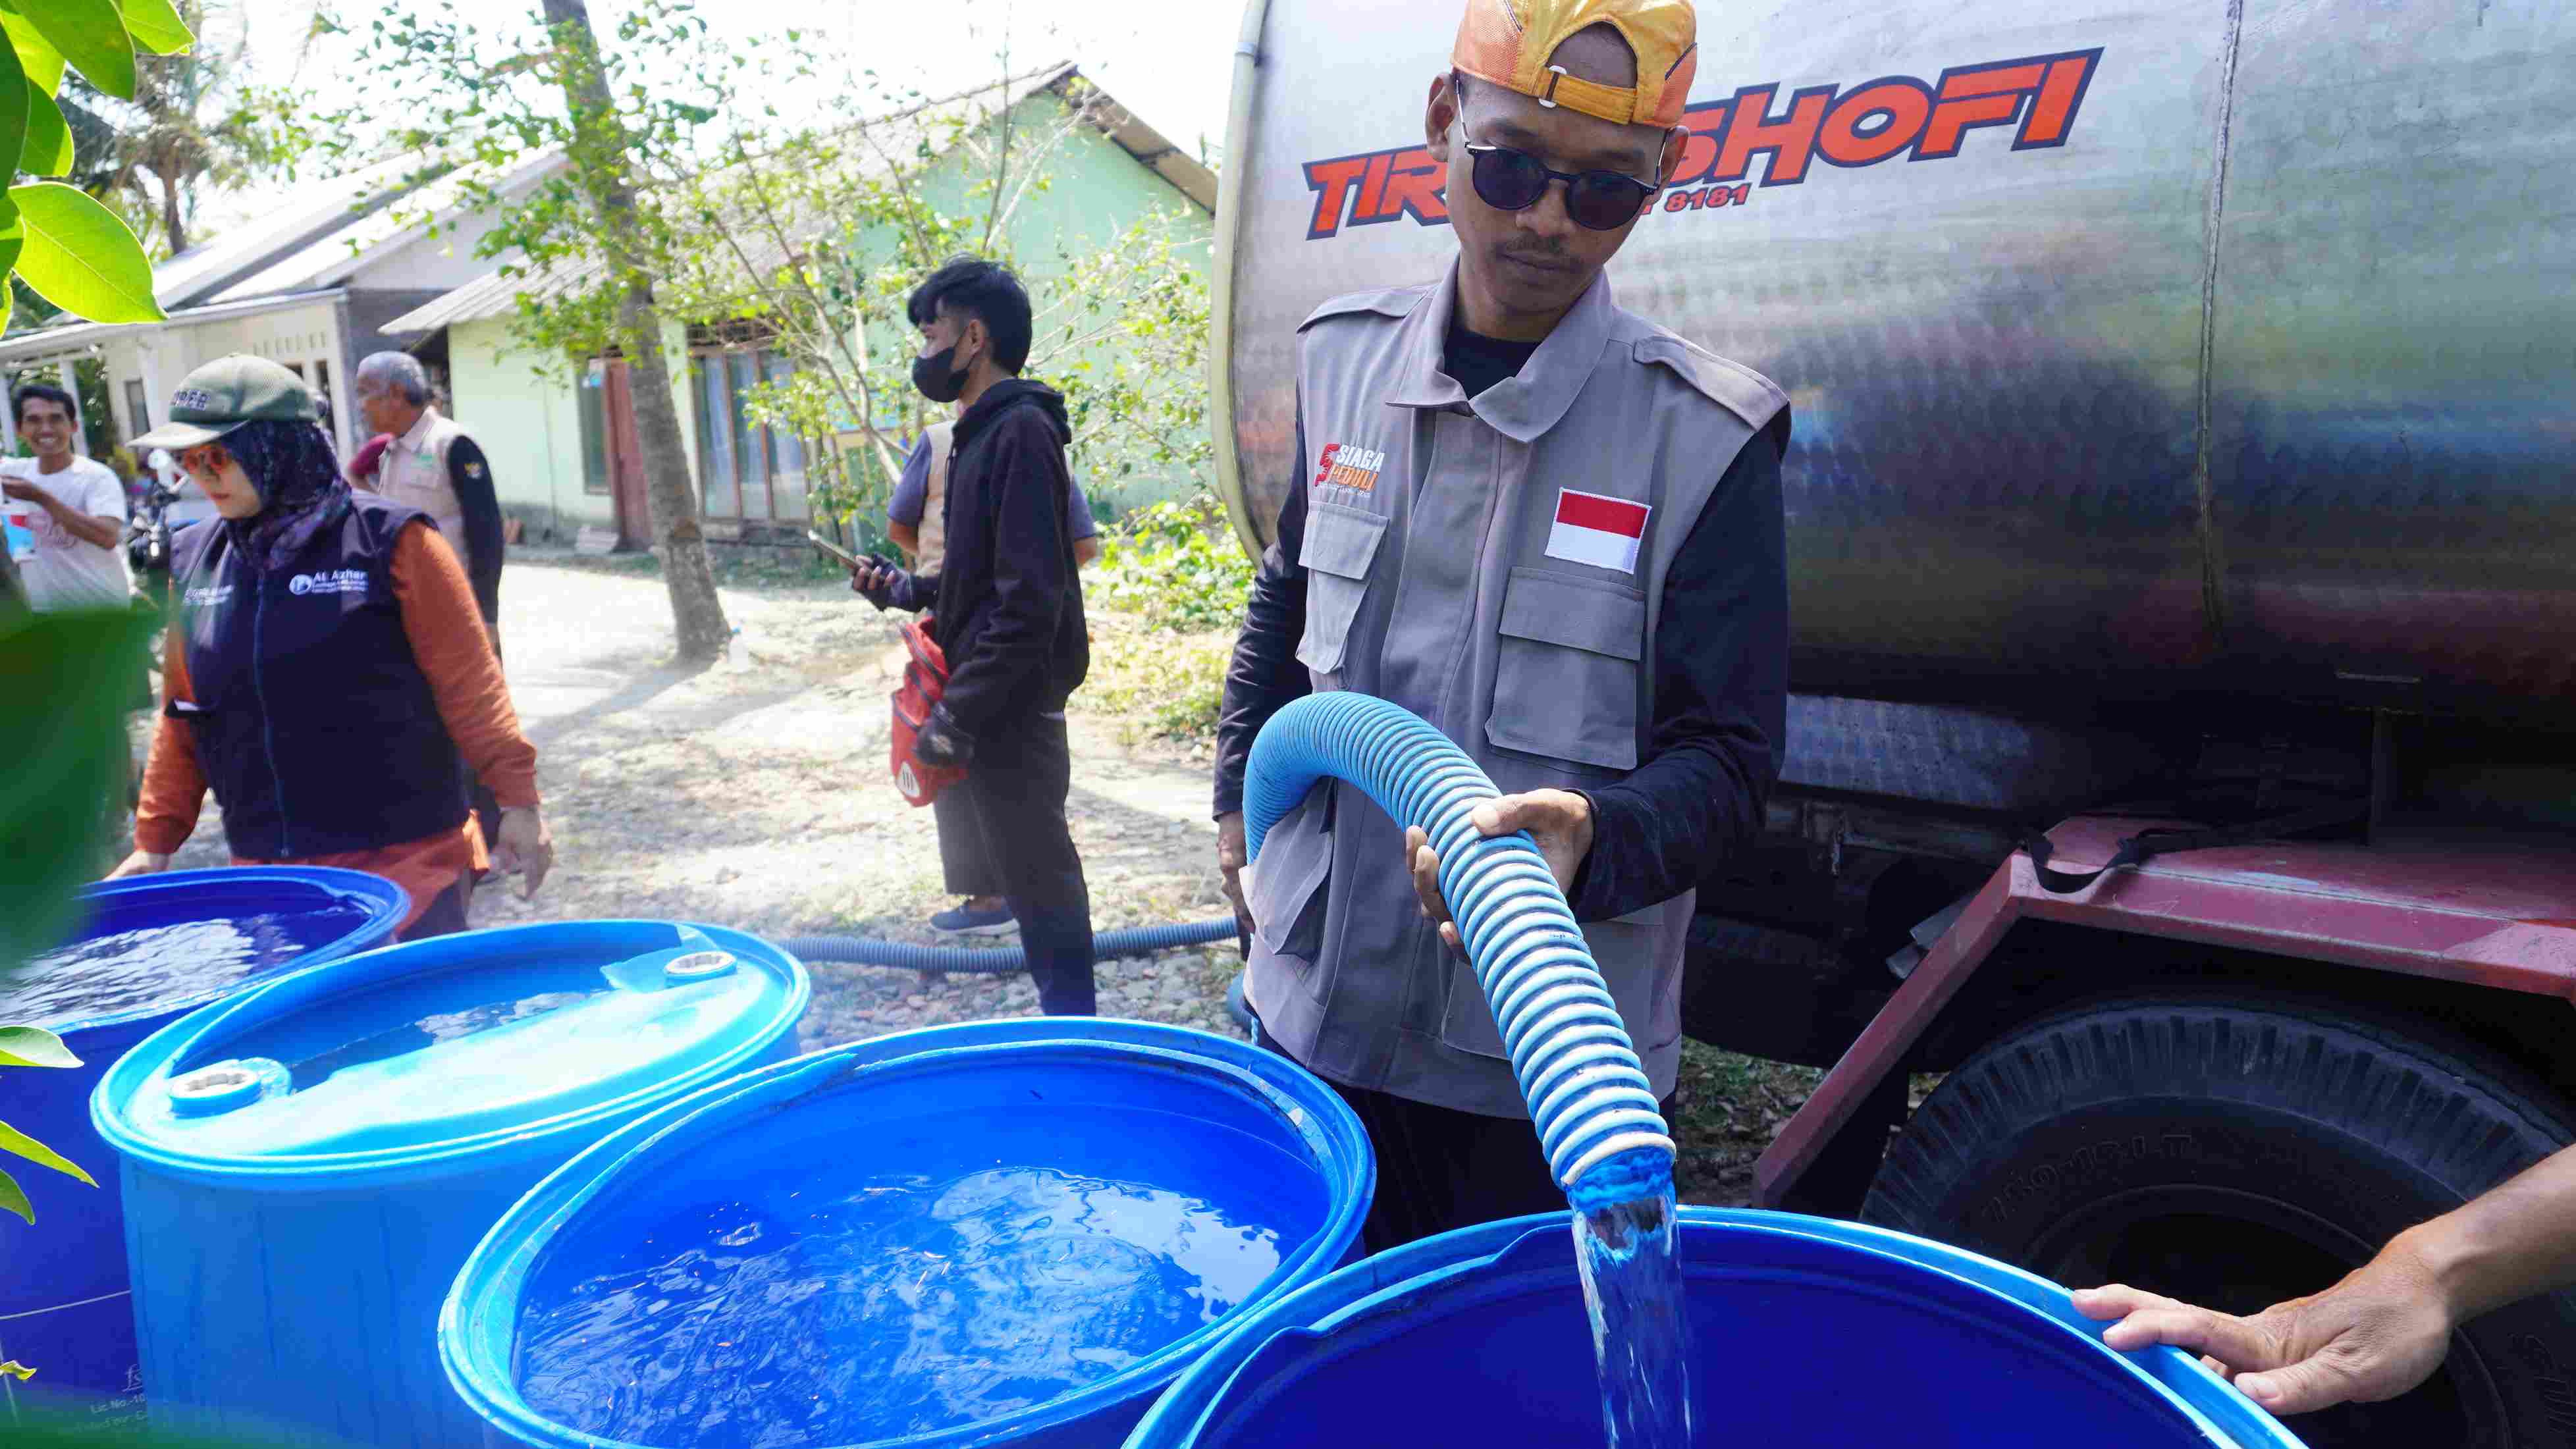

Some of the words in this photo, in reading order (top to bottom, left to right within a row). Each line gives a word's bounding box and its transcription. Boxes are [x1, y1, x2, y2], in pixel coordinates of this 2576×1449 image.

[1301, 144, 1451, 241] TIR
[1665, 182, 1752, 212] 8181
[1336, 444, 1385, 472] SIAGA
[1328, 463, 1379, 491] PEDULI
